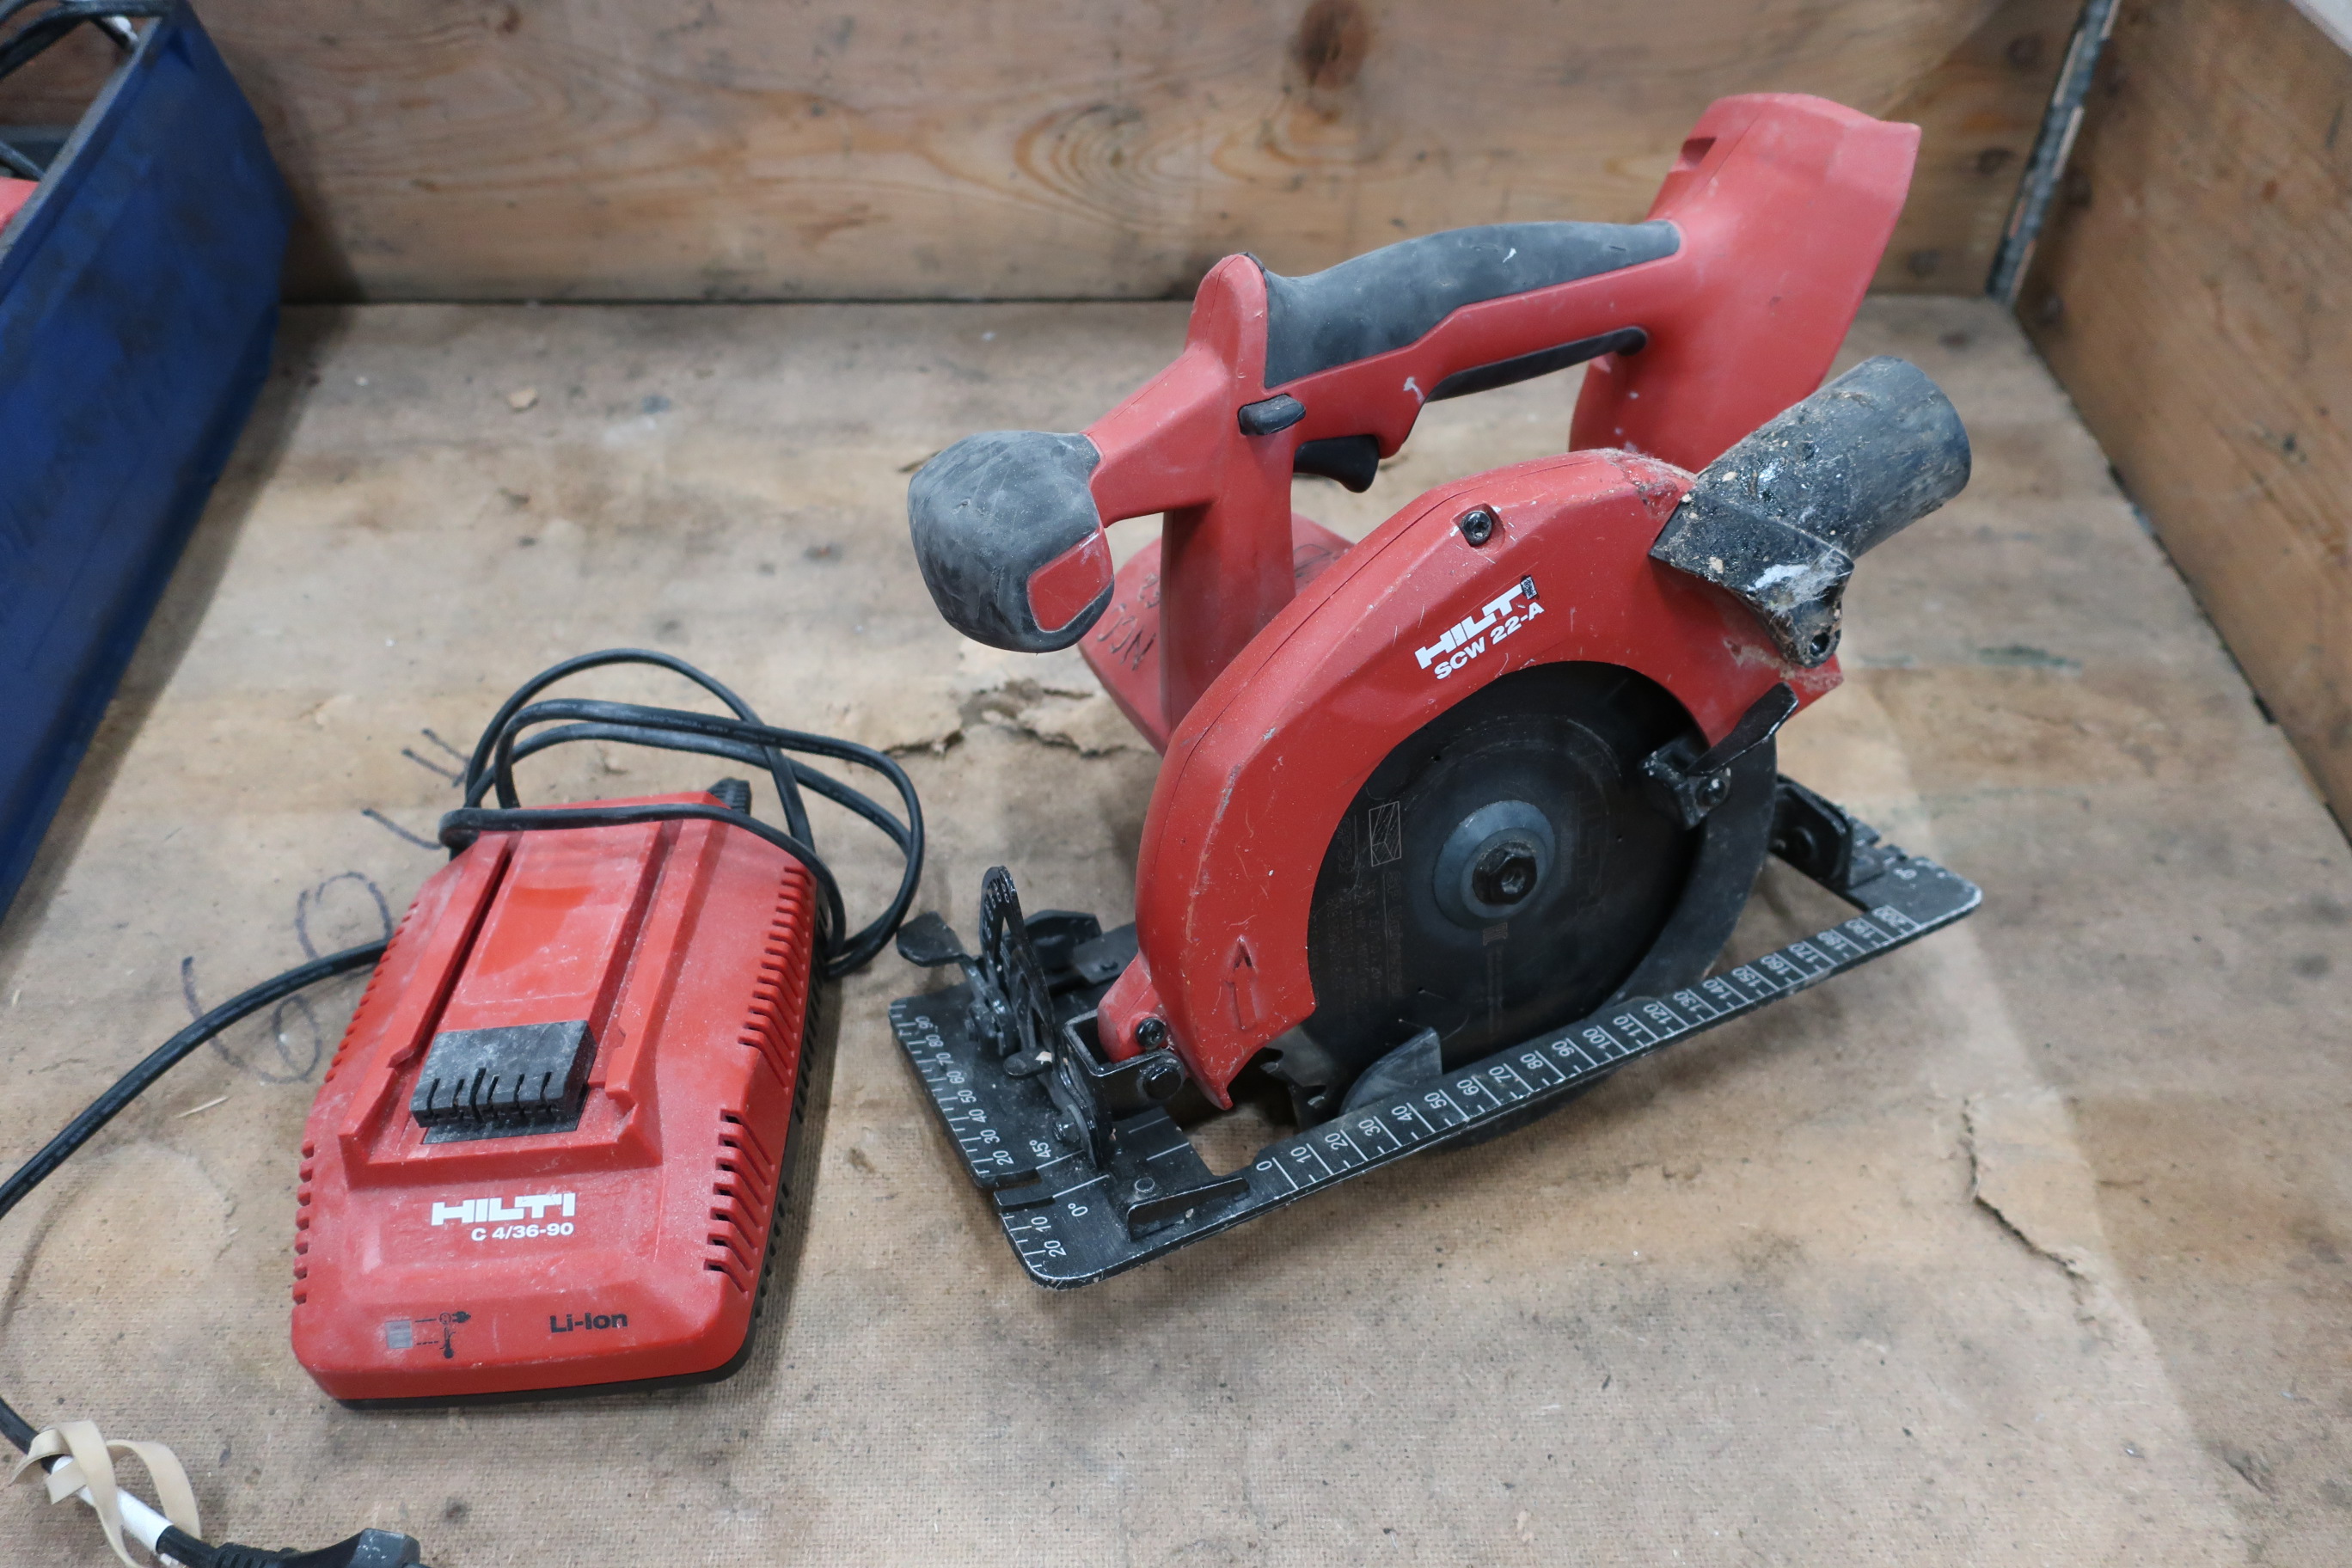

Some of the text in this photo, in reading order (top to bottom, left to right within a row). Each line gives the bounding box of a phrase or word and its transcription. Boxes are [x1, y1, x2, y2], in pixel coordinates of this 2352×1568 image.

[1434, 602, 1545, 679] SCW 22-A
[1257, 907, 1906, 1171] 0 10 20 30 40 50 60 70 80 90 100 110 120 130 140 150 160 170 180 190 200
[926, 1033, 944, 1048] 80
[936, 1052, 953, 1065] 70
[947, 1070, 965, 1084] 60
[958, 1090, 977, 1104] 50
[969, 1108, 987, 1124] 40
[981, 1130, 1000, 1144] 30
[994, 1150, 1014, 1166] 20
[1030, 1140, 1051, 1158] 45°
[432, 1192, 576, 1225] HILTI
[1069, 1203, 1088, 1216] 0°
[471, 1222, 574, 1240] C 4/36-90
[1031, 1216, 1067, 1258] 10 20
[549, 1312, 628, 1333] Li-Ion
